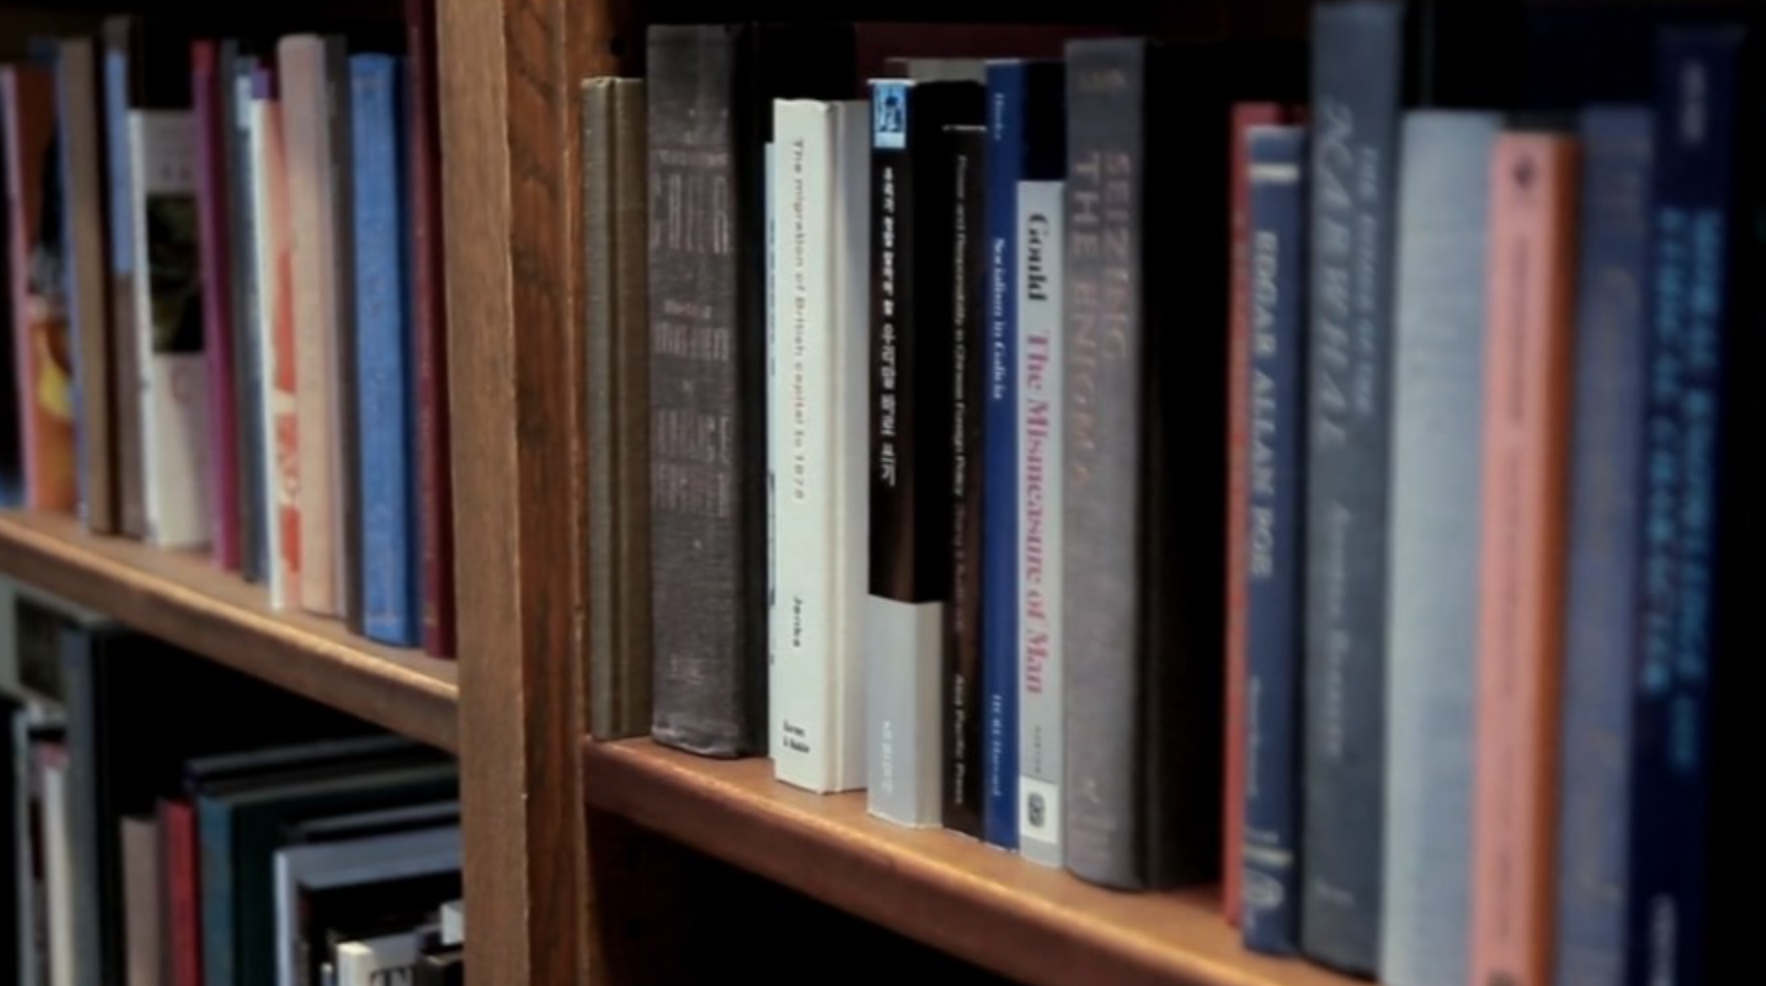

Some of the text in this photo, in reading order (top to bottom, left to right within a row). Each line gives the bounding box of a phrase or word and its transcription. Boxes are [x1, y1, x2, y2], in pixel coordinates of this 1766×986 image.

[793, 140, 804, 173] The
[793, 178, 805, 266] migration
[1026, 212, 1050, 302] Gould
[1104, 151, 1131, 360] SEIZING
[793, 270, 805, 292] of
[1072, 151, 1100, 489] THE ENIGMA
[793, 296, 806, 356] British
[793, 362, 805, 425] capital
[1252, 229, 1277, 579] EDGAR ALLAN POE
[794, 430, 804, 448] to
[1026, 329, 1051, 695] The Mismeasure of Man
